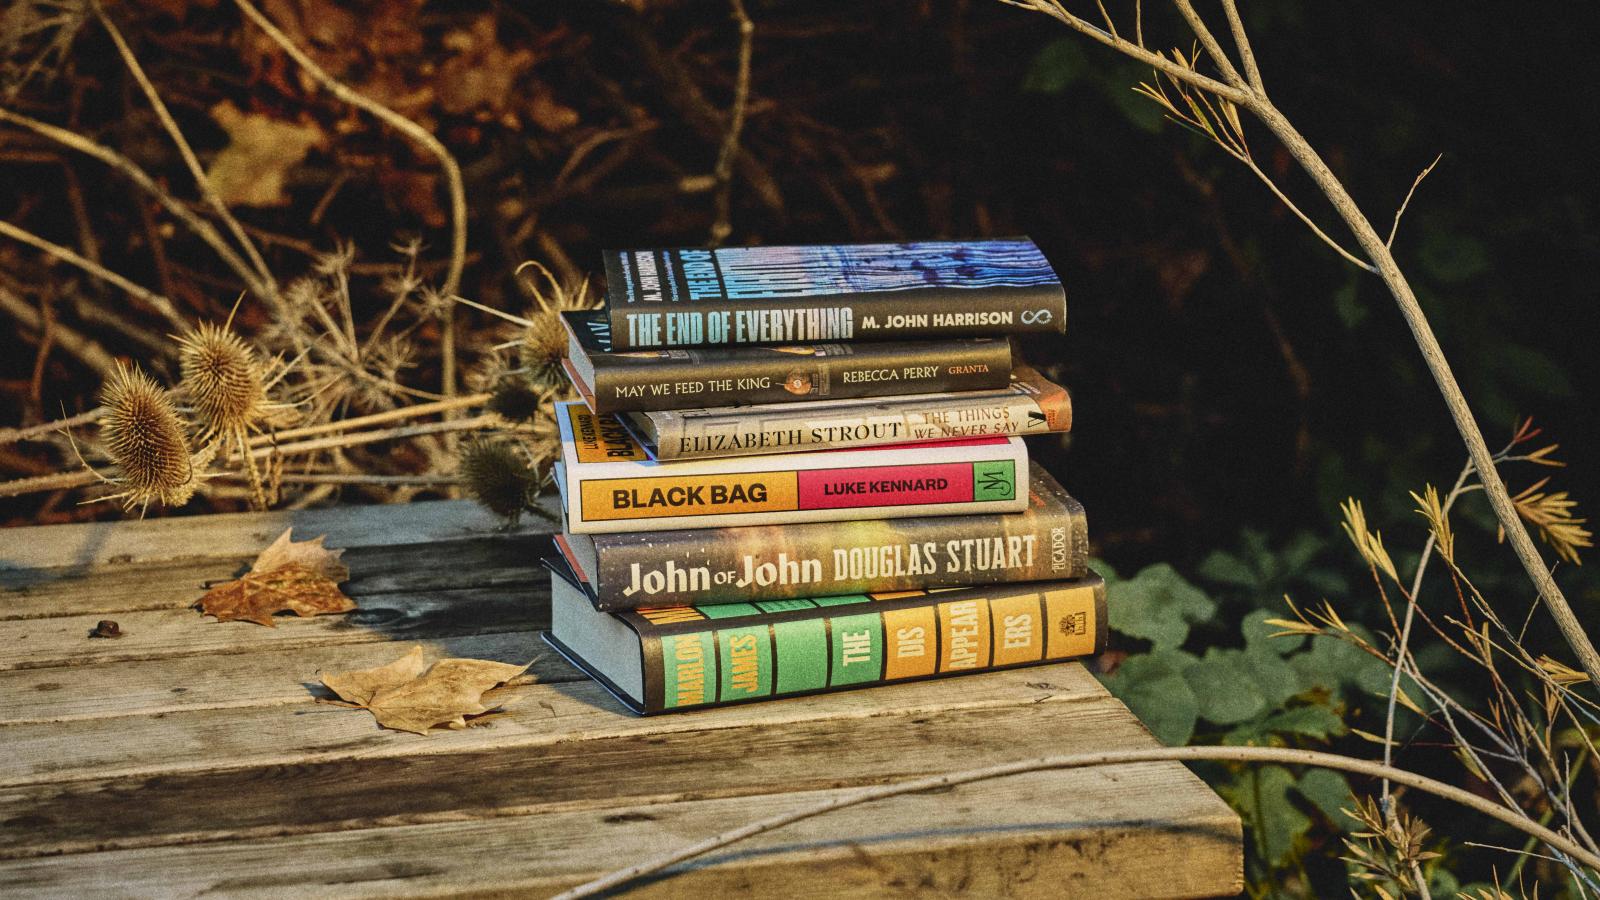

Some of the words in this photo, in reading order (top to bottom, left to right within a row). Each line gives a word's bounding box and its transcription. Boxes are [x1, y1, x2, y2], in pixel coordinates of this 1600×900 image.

[679, 250, 712, 261] OF
[682, 262, 717, 279] END
[687, 280, 721, 300] THE
[626, 313, 661, 346] THE
[666, 312, 703, 345] END
[707, 311, 731, 344] OF
[735, 307, 854, 343] EVERYTHING
[862, 316, 880, 329] M.
[884, 315, 928, 328] JOHN
[933, 311, 1013, 327] HARRISON
[843, 369, 899, 383] REBECCA
[903, 366, 939, 379] PERRY
[948, 364, 989, 375] GRANTA
[616, 385, 645, 398] MAY
[650, 383, 670, 395] WE
[675, 382, 704, 394] FEED
[708, 380, 733, 392] THE
[737, 377, 770, 390] KING
[923, 411, 951, 424] THE
[958, 406, 1010, 422] THINGS
[679, 429, 802, 453] ELIZABETH
[811, 422, 902, 444] STROUT
[914, 427, 935, 439] WE
[941, 423, 987, 437] NEVER
[994, 421, 1019, 433] SAY
[613, 486, 705, 509] BLACK
[711, 483, 767, 505] BAG
[824, 481, 866, 495] LUKE
[870, 478, 948, 493] KENNARD
[833, 541, 937, 581] DOUGLAS
[947, 534, 1036, 573] STUART
[1051, 527, 1065, 571] PICADOR
[622, 561, 710, 597] John
[714, 571, 736, 585] OF
[735, 553, 822, 588] John
[896, 626, 925, 658] DIS
[949, 602, 978, 669] APPEAR
[1004, 613, 1032, 649] ERS
[842, 629, 871, 667] THE
[675, 634, 704, 706] MARLON
[730, 634, 758, 693] JAMES
